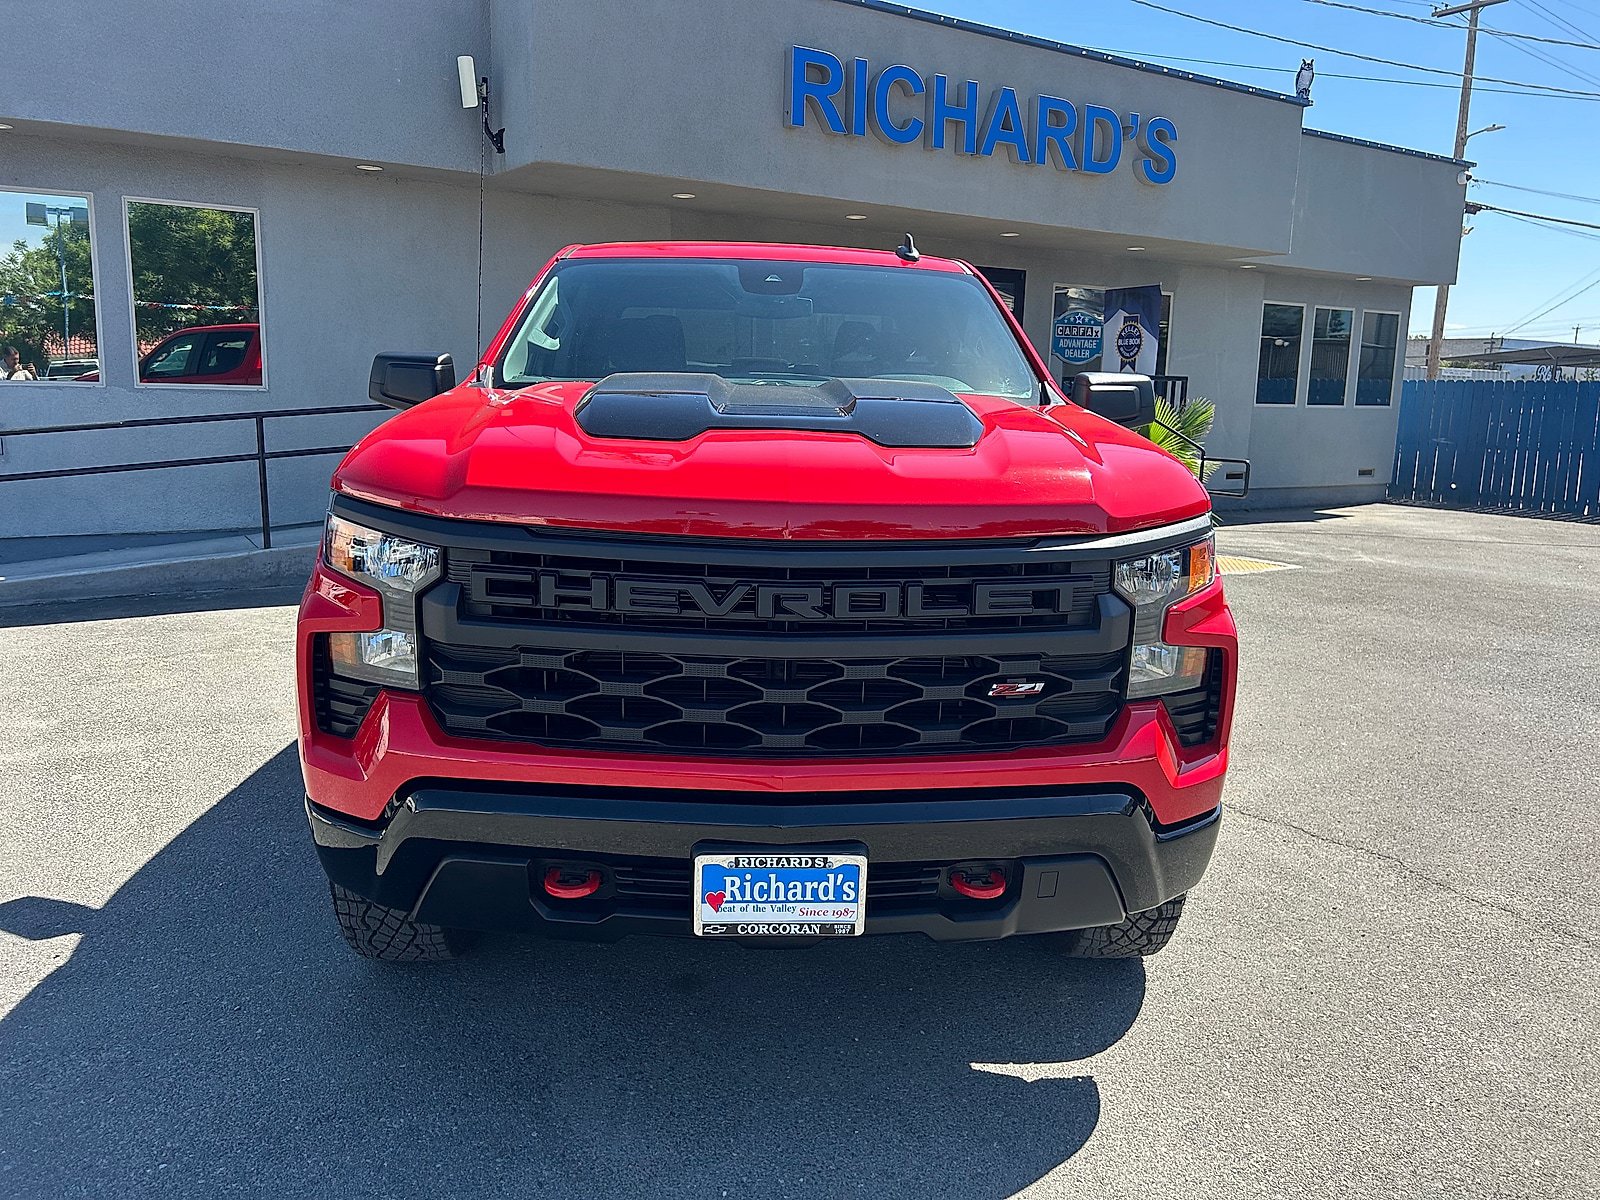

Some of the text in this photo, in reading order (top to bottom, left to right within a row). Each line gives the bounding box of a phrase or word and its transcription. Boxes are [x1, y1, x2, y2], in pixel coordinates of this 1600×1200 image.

[784, 44, 1178, 185] RICHARD'S
[1057, 326, 1100, 338] CARFAX
[1059, 339, 1097, 349] ADVANTAGE
[1064, 349, 1090, 358] DEALER
[470, 566, 1094, 619] CHEVROLET
[988, 683, 1045, 696] Z71
[723, 873, 856, 902] Richard's
[740, 904, 750, 912] of
[752, 904, 767, 913] the
[770, 904, 797, 914] Valley
[798, 907, 829, 917] Since
[831, 907, 856, 919] 1987
[737, 924, 821, 935] CORCORAN
